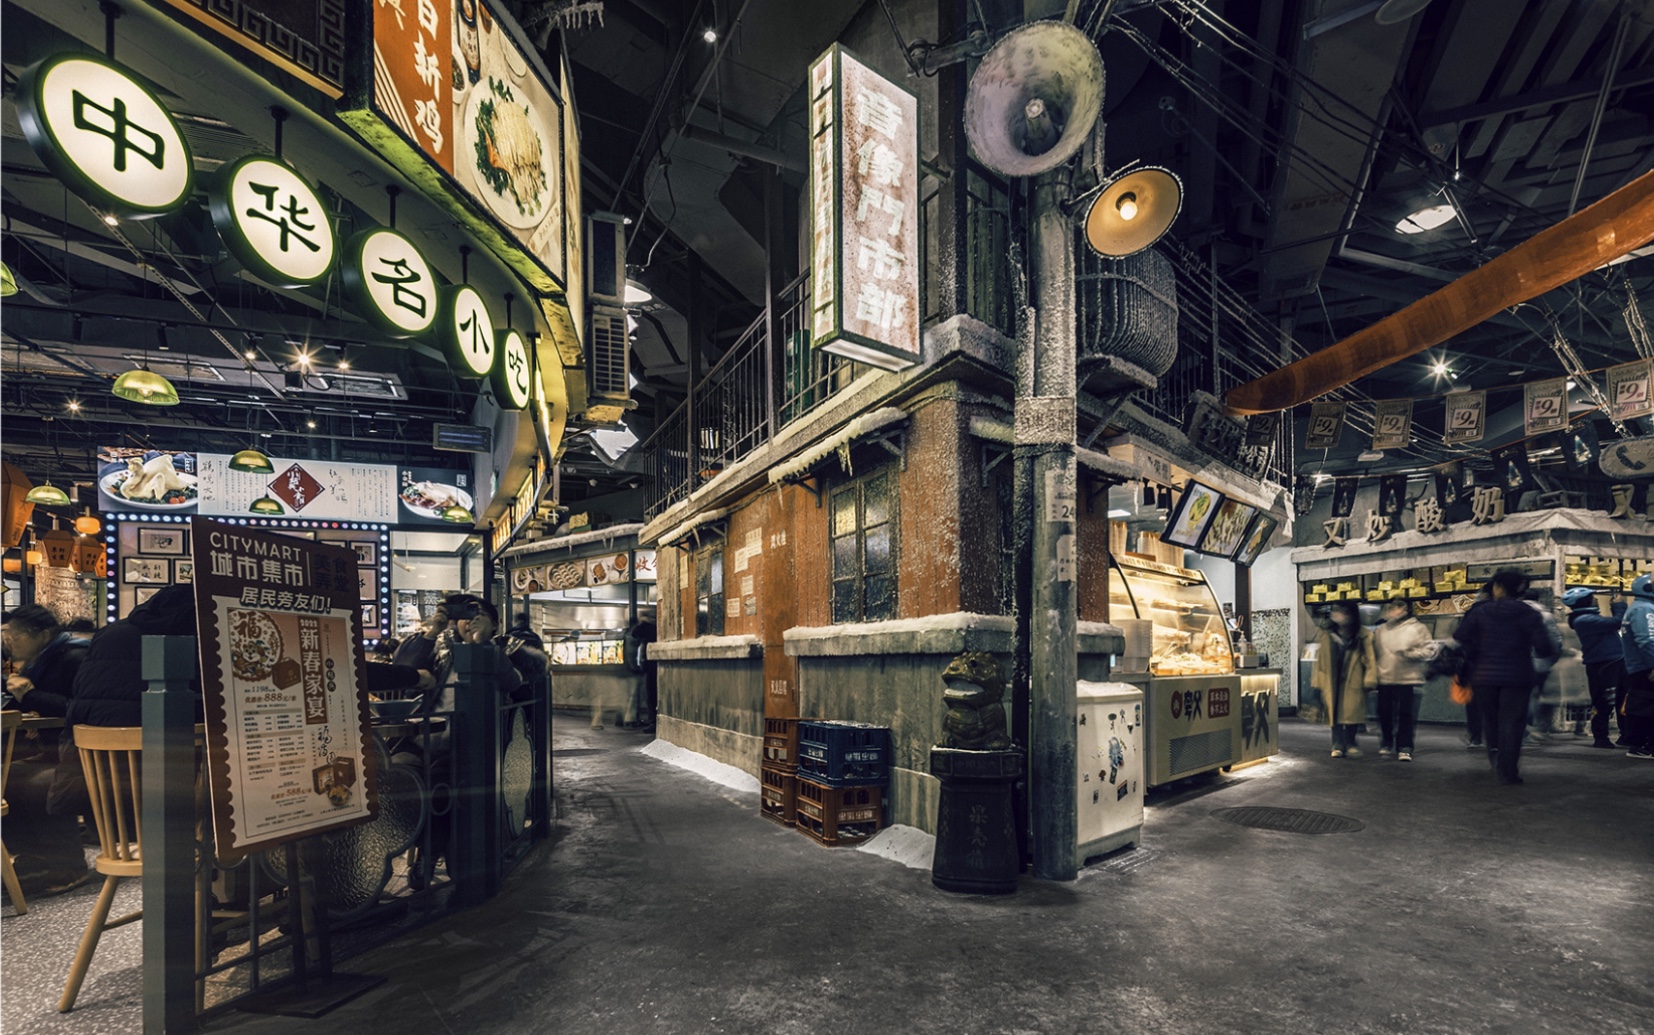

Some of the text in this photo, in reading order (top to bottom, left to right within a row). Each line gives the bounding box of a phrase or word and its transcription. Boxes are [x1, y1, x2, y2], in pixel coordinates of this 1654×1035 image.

[72, 89, 527, 396] 中华名小吃
[1323, 487, 1504, 548] 又炒酸奶
[210, 531, 302, 562] CITYMART
[210, 550, 304, 586] 城市集市
[241, 586, 331, 612] 居民旁友们!
[233, 611, 262, 639] 福
[300, 628, 325, 719] 新春家宴
